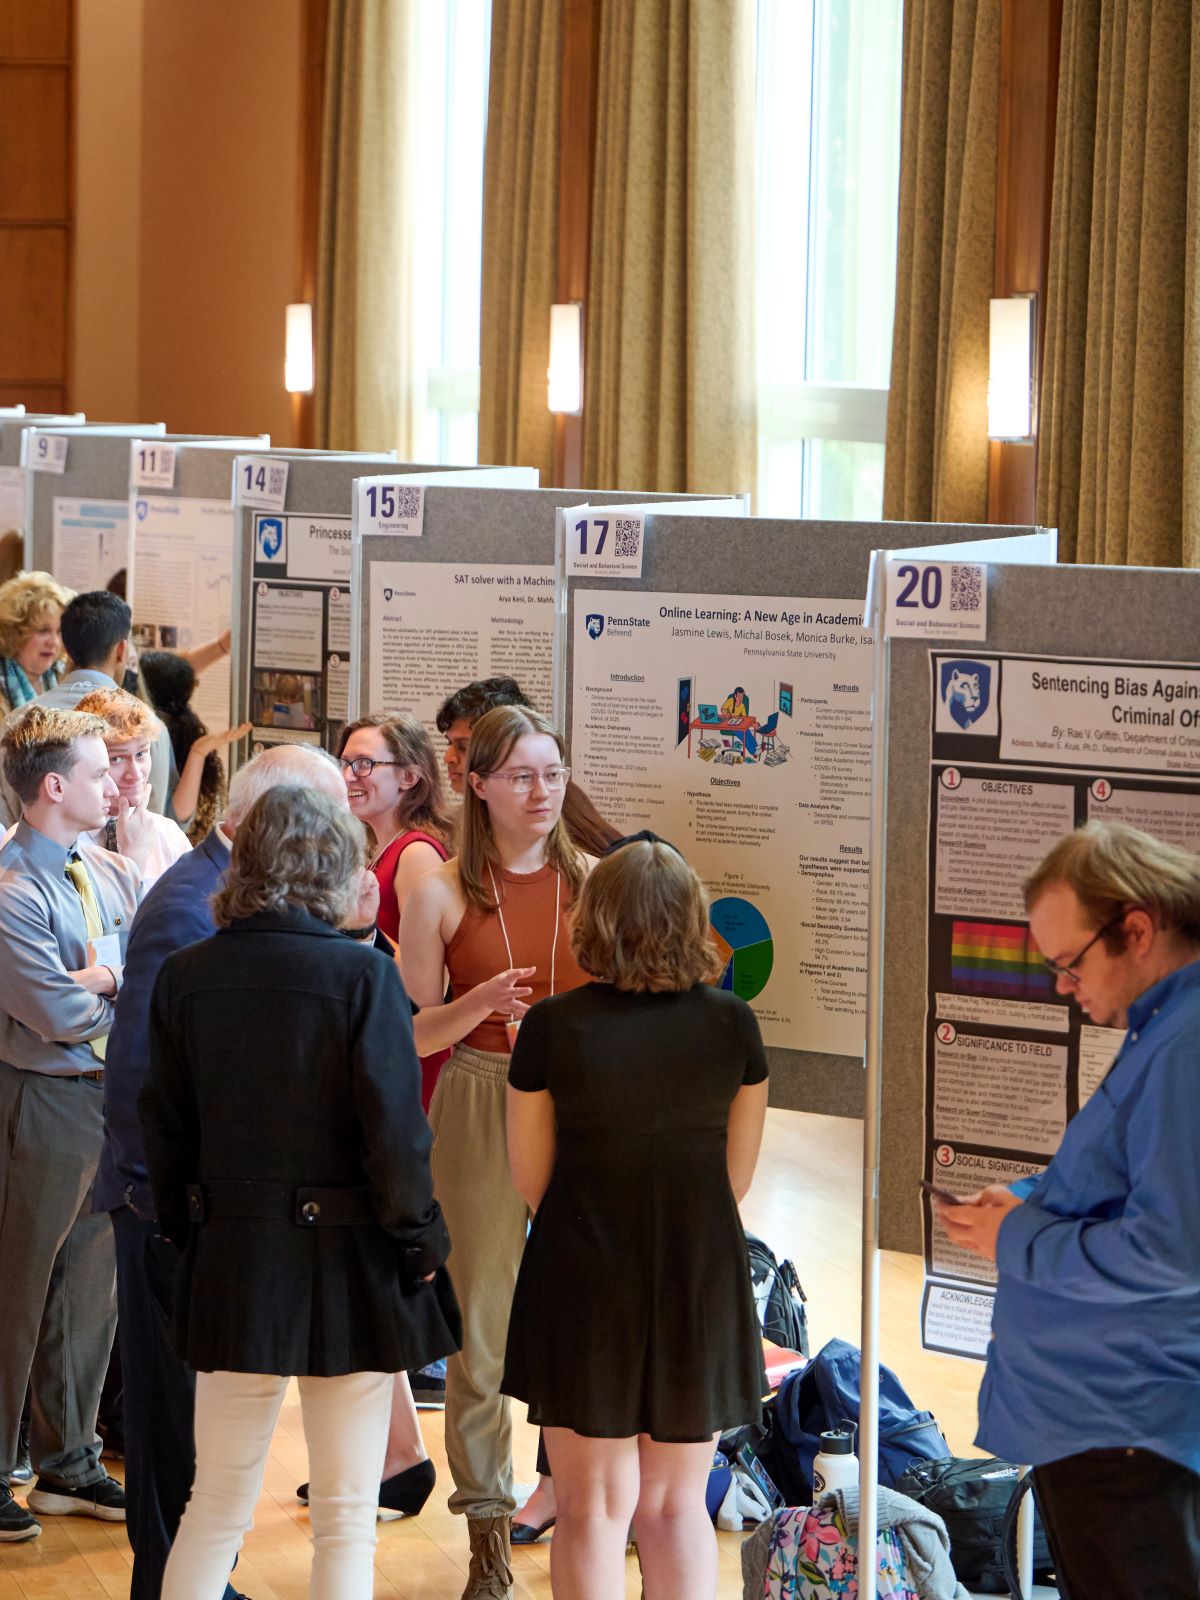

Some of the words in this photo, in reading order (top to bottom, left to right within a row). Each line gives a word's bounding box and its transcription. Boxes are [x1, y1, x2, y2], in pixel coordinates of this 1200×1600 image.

[39, 438, 48, 458] 9
[139, 450, 156, 472] 11
[244, 465, 266, 491] 14
[366, 486, 395, 519] 15
[379, 522, 409, 531] Engineering
[576, 520, 609, 555] 17
[329, 545, 339, 555] The
[455, 575, 469, 584] SAT
[471, 575, 494, 585] solver
[496, 576, 515, 586] with
[896, 565, 942, 609] 20
[499, 596, 511, 604] Arya
[512, 596, 527, 604] Keni,
[528, 596, 536, 604] Dr.
[491, 617, 524, 625] Methodology
[608, 616, 651, 627] PennState
[660, 607, 692, 619] Online
[695, 608, 741, 622] Learning:
[744, 610, 752, 621] A
[755, 611, 778, 622] New
[781, 612, 801, 625] Age
[803, 613, 813, 624] in
[929, 620, 958, 628] Behavioral
[607, 629, 632, 637] Behrend
[672, 627, 705, 638] Jasmine
[707, 629, 732, 640] Lewis,
[735, 630, 763, 641] Michal
[766, 631, 794, 643] Bosek,
[796, 633, 828, 643] Monica
[831, 634, 858, 646] Burke,
[744, 648, 785, 659] Pennsylvania
[787, 650, 803, 658] State
[805, 651, 837, 661] University
[611, 673, 645, 682] Introduction
[833, 684, 859, 692] Methods
[1032, 672, 1109, 699] Sentencing
[1115, 678, 1148, 697] Bias
[1153, 680, 1200, 702] Again
[1112, 706, 1175, 726] Criminal
[1068, 728, 1084, 739] Rae
[1124, 732, 1168, 744] Department
[1169, 736, 1177, 745] of
[710, 777, 741, 787] Objectives
[947, 770, 956, 786] 1
[982, 782, 1034, 795] OBJECTIVES
[1097, 781, 1106, 798] 4
[840, 845, 863, 854] Results
[799, 863, 829, 871] hypotheses
[724, 872, 740, 880] Figure
[801, 870, 834, 878] Demographics
[802, 962, 825, 970] Frequency
[805, 969, 823, 977] Figures
[832, 989, 851, 998] admitting
[942, 1025, 951, 1041] 2
[957, 1037, 1014, 1053] SIGNIFICANCE
[1016, 1043, 1028, 1054] TO
[1030, 1046, 1053, 1057] FIELD
[941, 1147, 951, 1164] 3
[957, 1155, 986, 1169] SOCIAL
[941, 1291, 993, 1308] ACKNOWLEDGE
